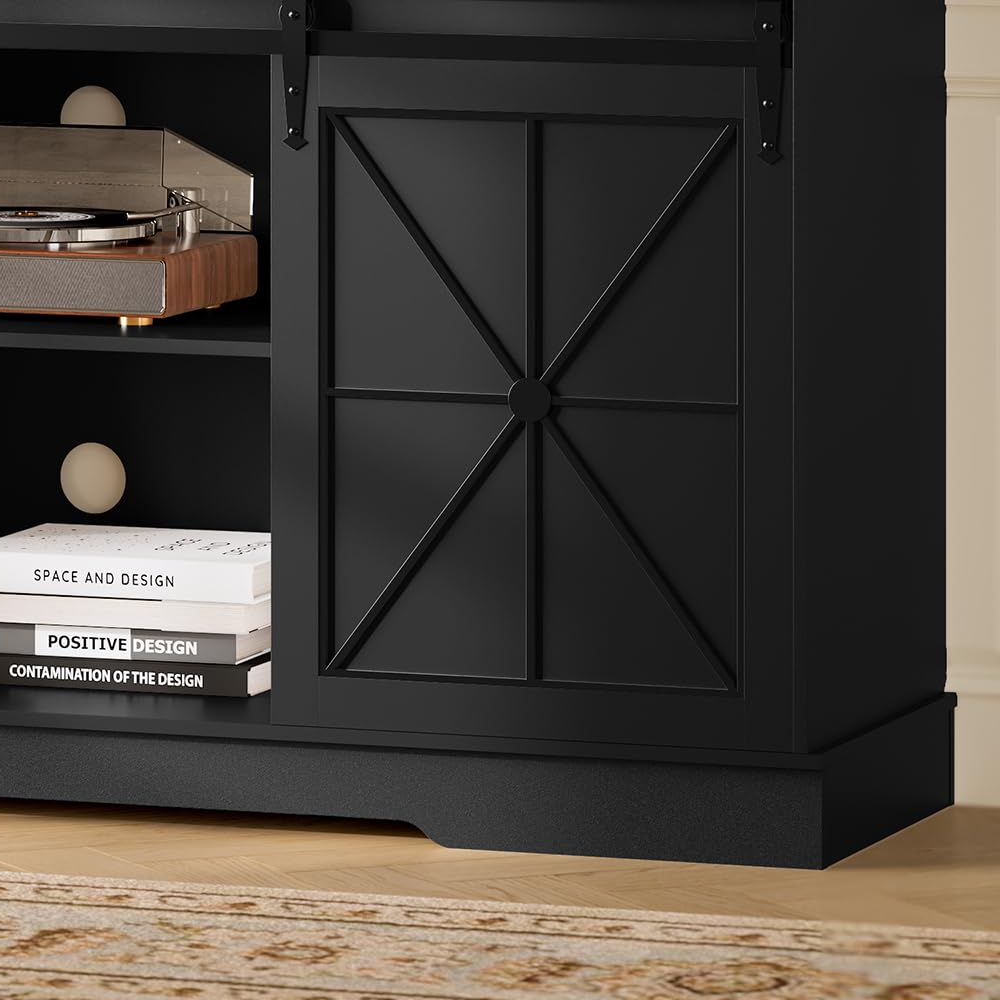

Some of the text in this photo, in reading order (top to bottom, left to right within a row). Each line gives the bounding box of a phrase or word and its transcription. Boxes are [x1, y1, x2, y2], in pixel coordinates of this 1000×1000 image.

[33, 568, 175, 588] SPACE AND DESIGN
[48, 634, 199, 656] POSITIVE DESIGN
[9, 664, 204, 688] CONTAMINATION OF THE DESIGN
